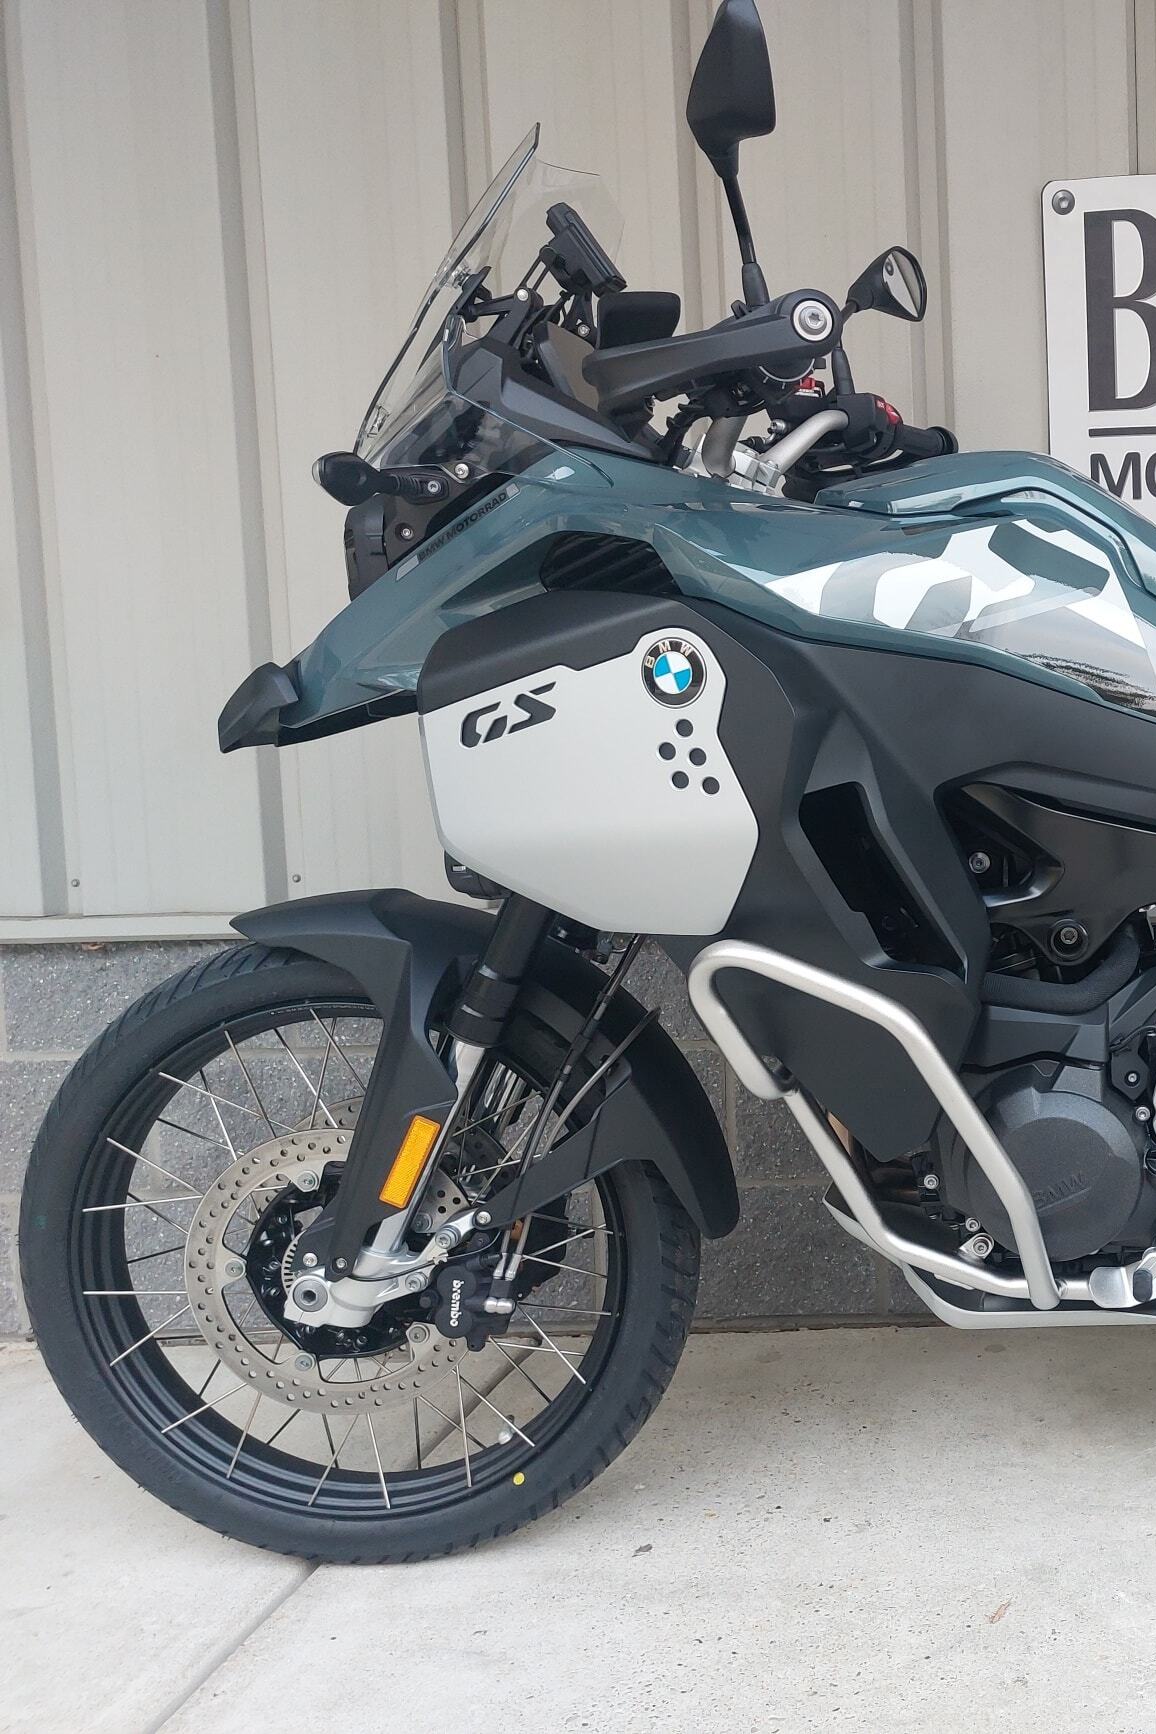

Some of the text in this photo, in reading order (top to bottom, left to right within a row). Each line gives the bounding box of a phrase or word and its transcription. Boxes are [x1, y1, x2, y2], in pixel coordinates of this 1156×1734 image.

[418, 492, 507, 562] BMW MOTORRAD
[645, 640, 694, 669] BMW
[460, 681, 556, 748] GS
[450, 1280, 464, 1327] brembo
